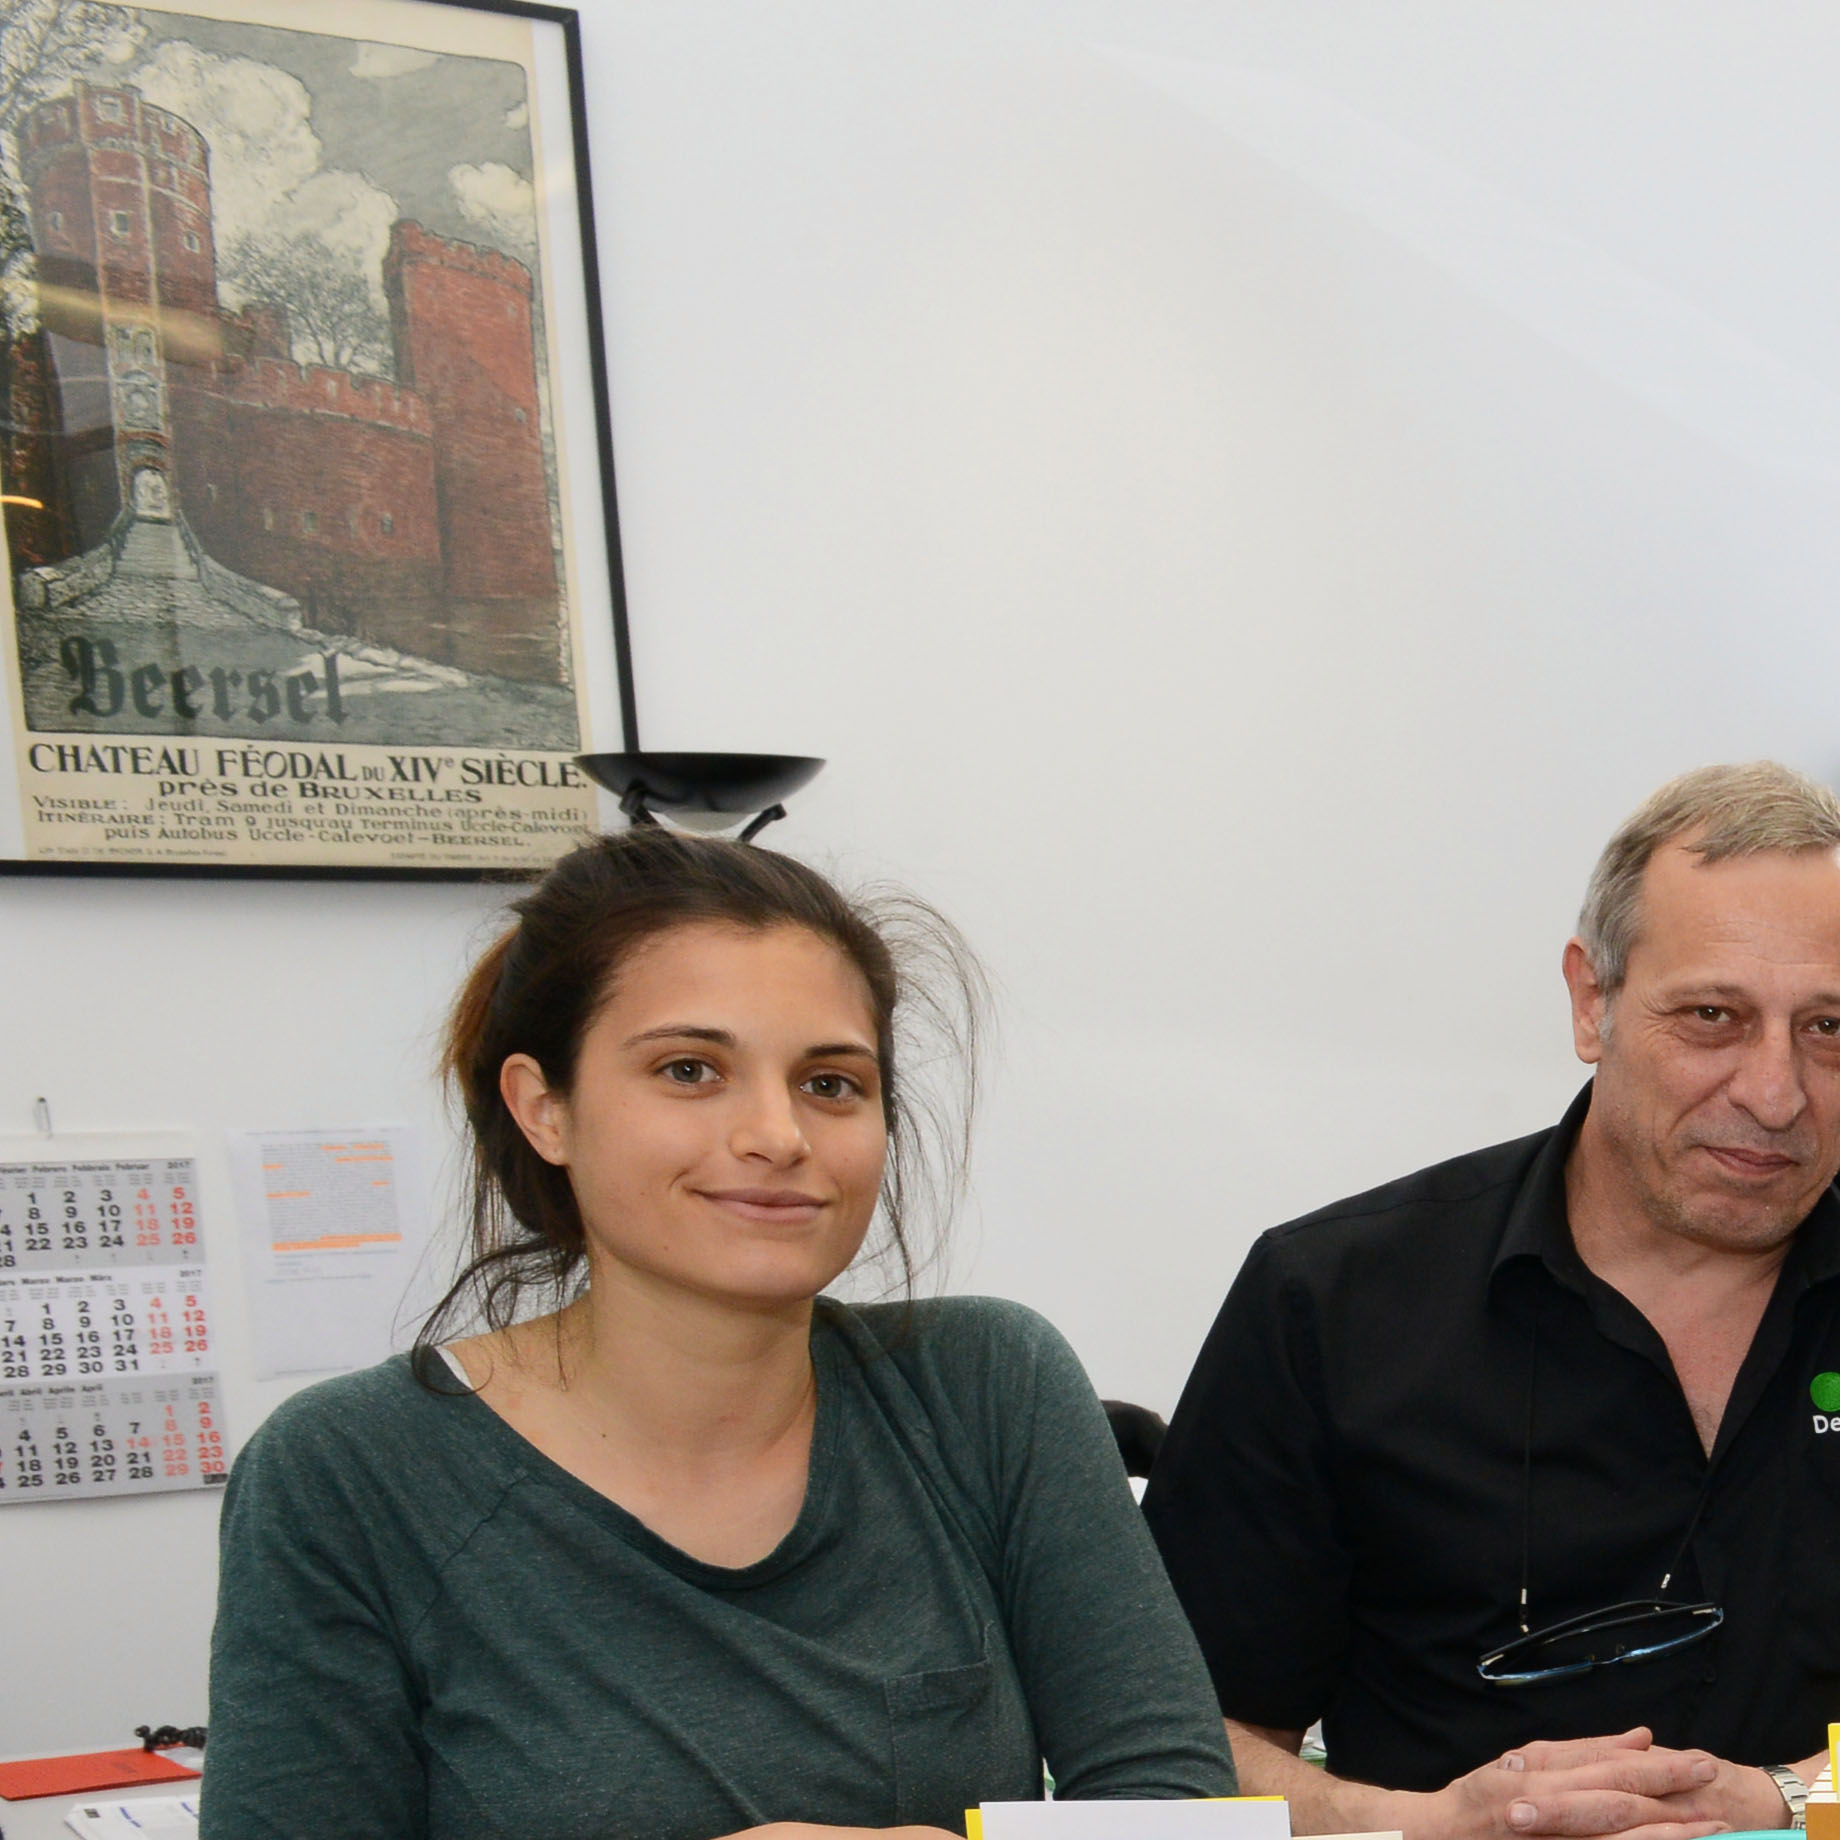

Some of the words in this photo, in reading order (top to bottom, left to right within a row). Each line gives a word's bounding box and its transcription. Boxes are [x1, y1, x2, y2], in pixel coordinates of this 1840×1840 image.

[60, 636, 350, 727] Beersel
[29, 743, 199, 775] CHATEAU
[216, 745, 356, 781] FÉODAL
[361, 765, 385, 782] DU
[461, 752, 588, 788] SIÈCLE.
[158, 779, 239, 797] près
[250, 782, 288, 799] de
[299, 782, 483, 803] BRUXELLES
[217, 800, 292, 815] Samedi
[304, 803, 324, 816] et
[335, 802, 442, 819] Dimanche
[449, 804, 588, 822] (après-midi)
[175, 813, 235, 828] Tram
[245, 816, 258, 830] 9
[361, 817, 454, 832] Terminus
[104, 828, 150, 844] puis
[158, 829, 238, 842] Autobus
[28, 1193, 36, 1204] 1
[64, 1191, 75, 1202] 2
[101, 1190, 112, 1201] 3
[137, 1189, 150, 1200] 4
[173, 1187, 185, 1198] 5
[28, 1208, 40, 1219] 8
[66, 1207, 77, 1218] 9
[98, 1205, 120, 1216] 10
[135, 1204, 155, 1215] 11
[170, 1202, 193, 1214] 12
